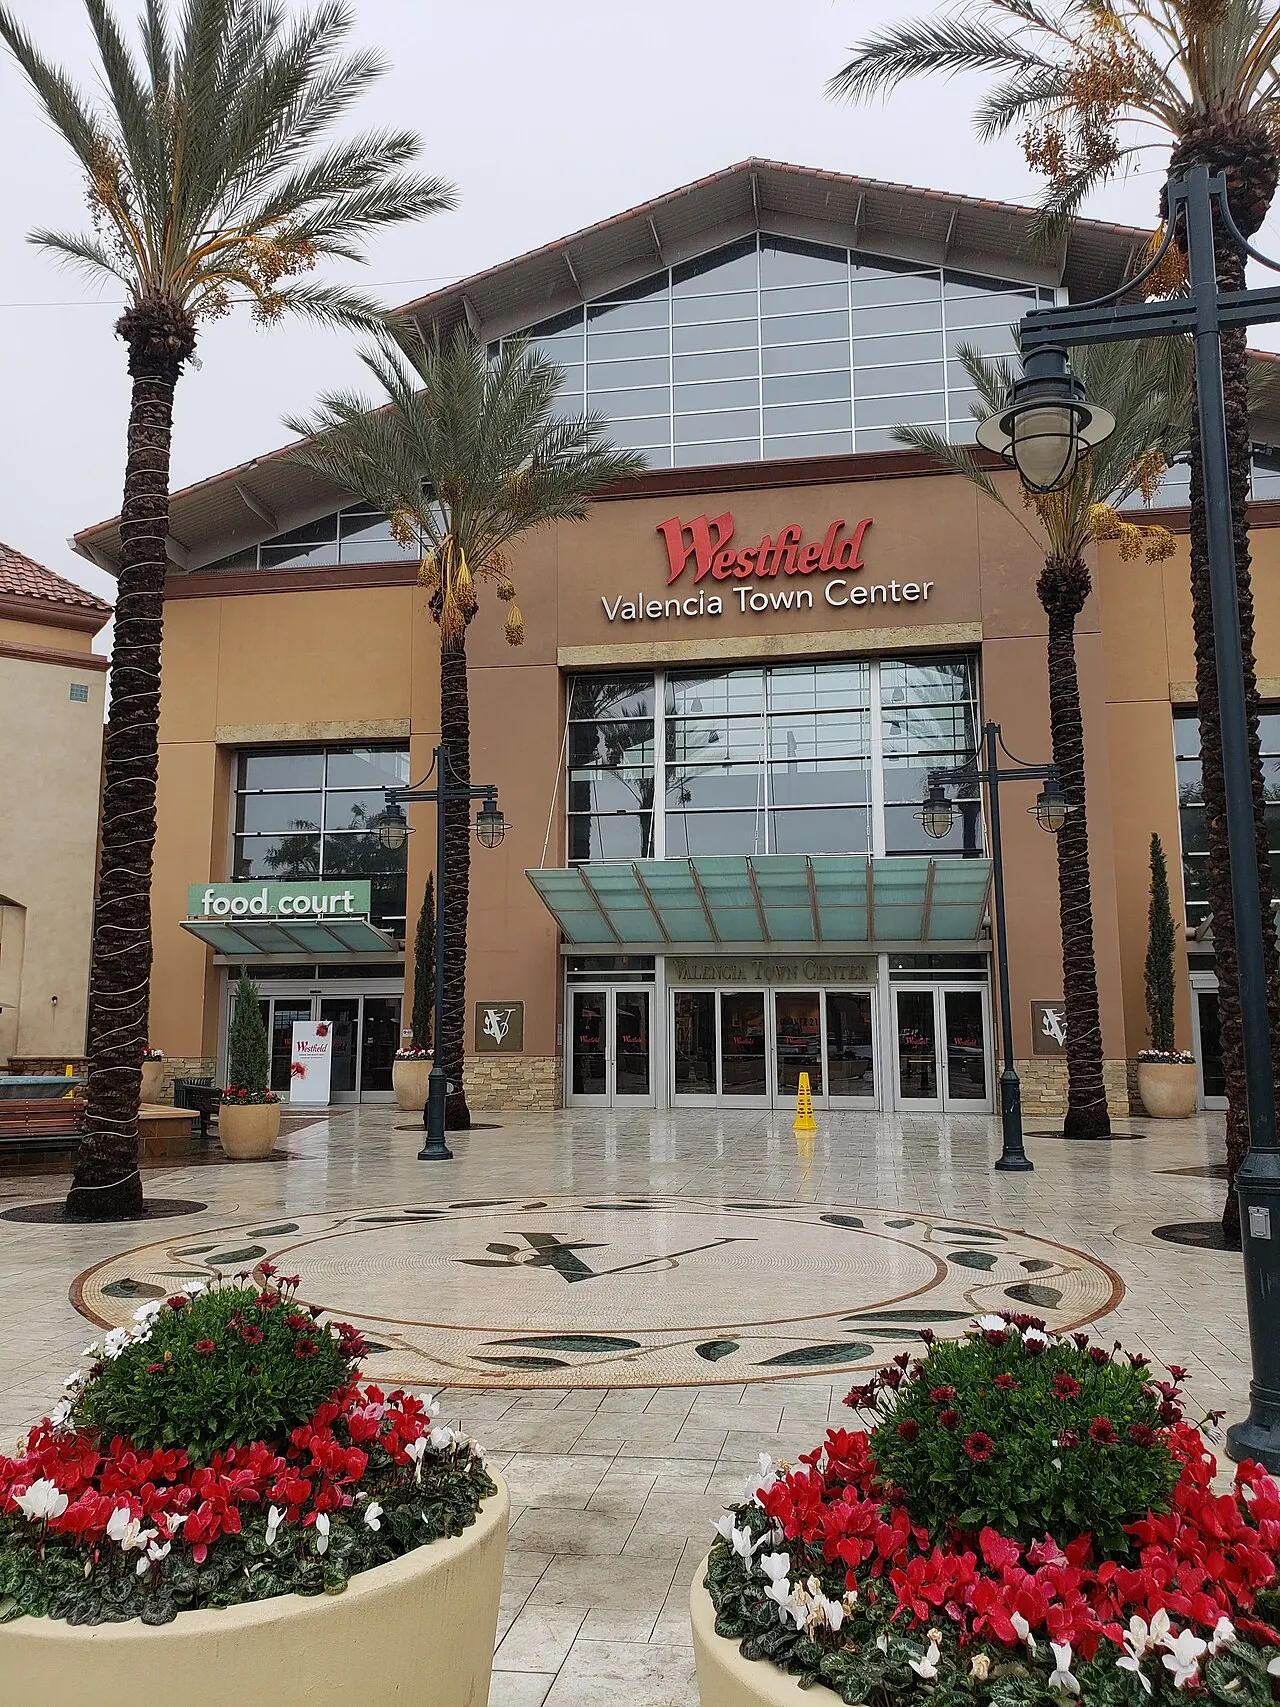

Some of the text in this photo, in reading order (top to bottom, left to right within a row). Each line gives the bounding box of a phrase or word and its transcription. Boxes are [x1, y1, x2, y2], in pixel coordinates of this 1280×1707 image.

[655, 511, 873, 585] Westfield
[601, 579, 934, 621] Valencia Town Center
[202, 887, 355, 915] food court
[673, 959, 869, 981] VALENCIA TOWN CENTER
[296, 1041, 328, 1053] Westfield
